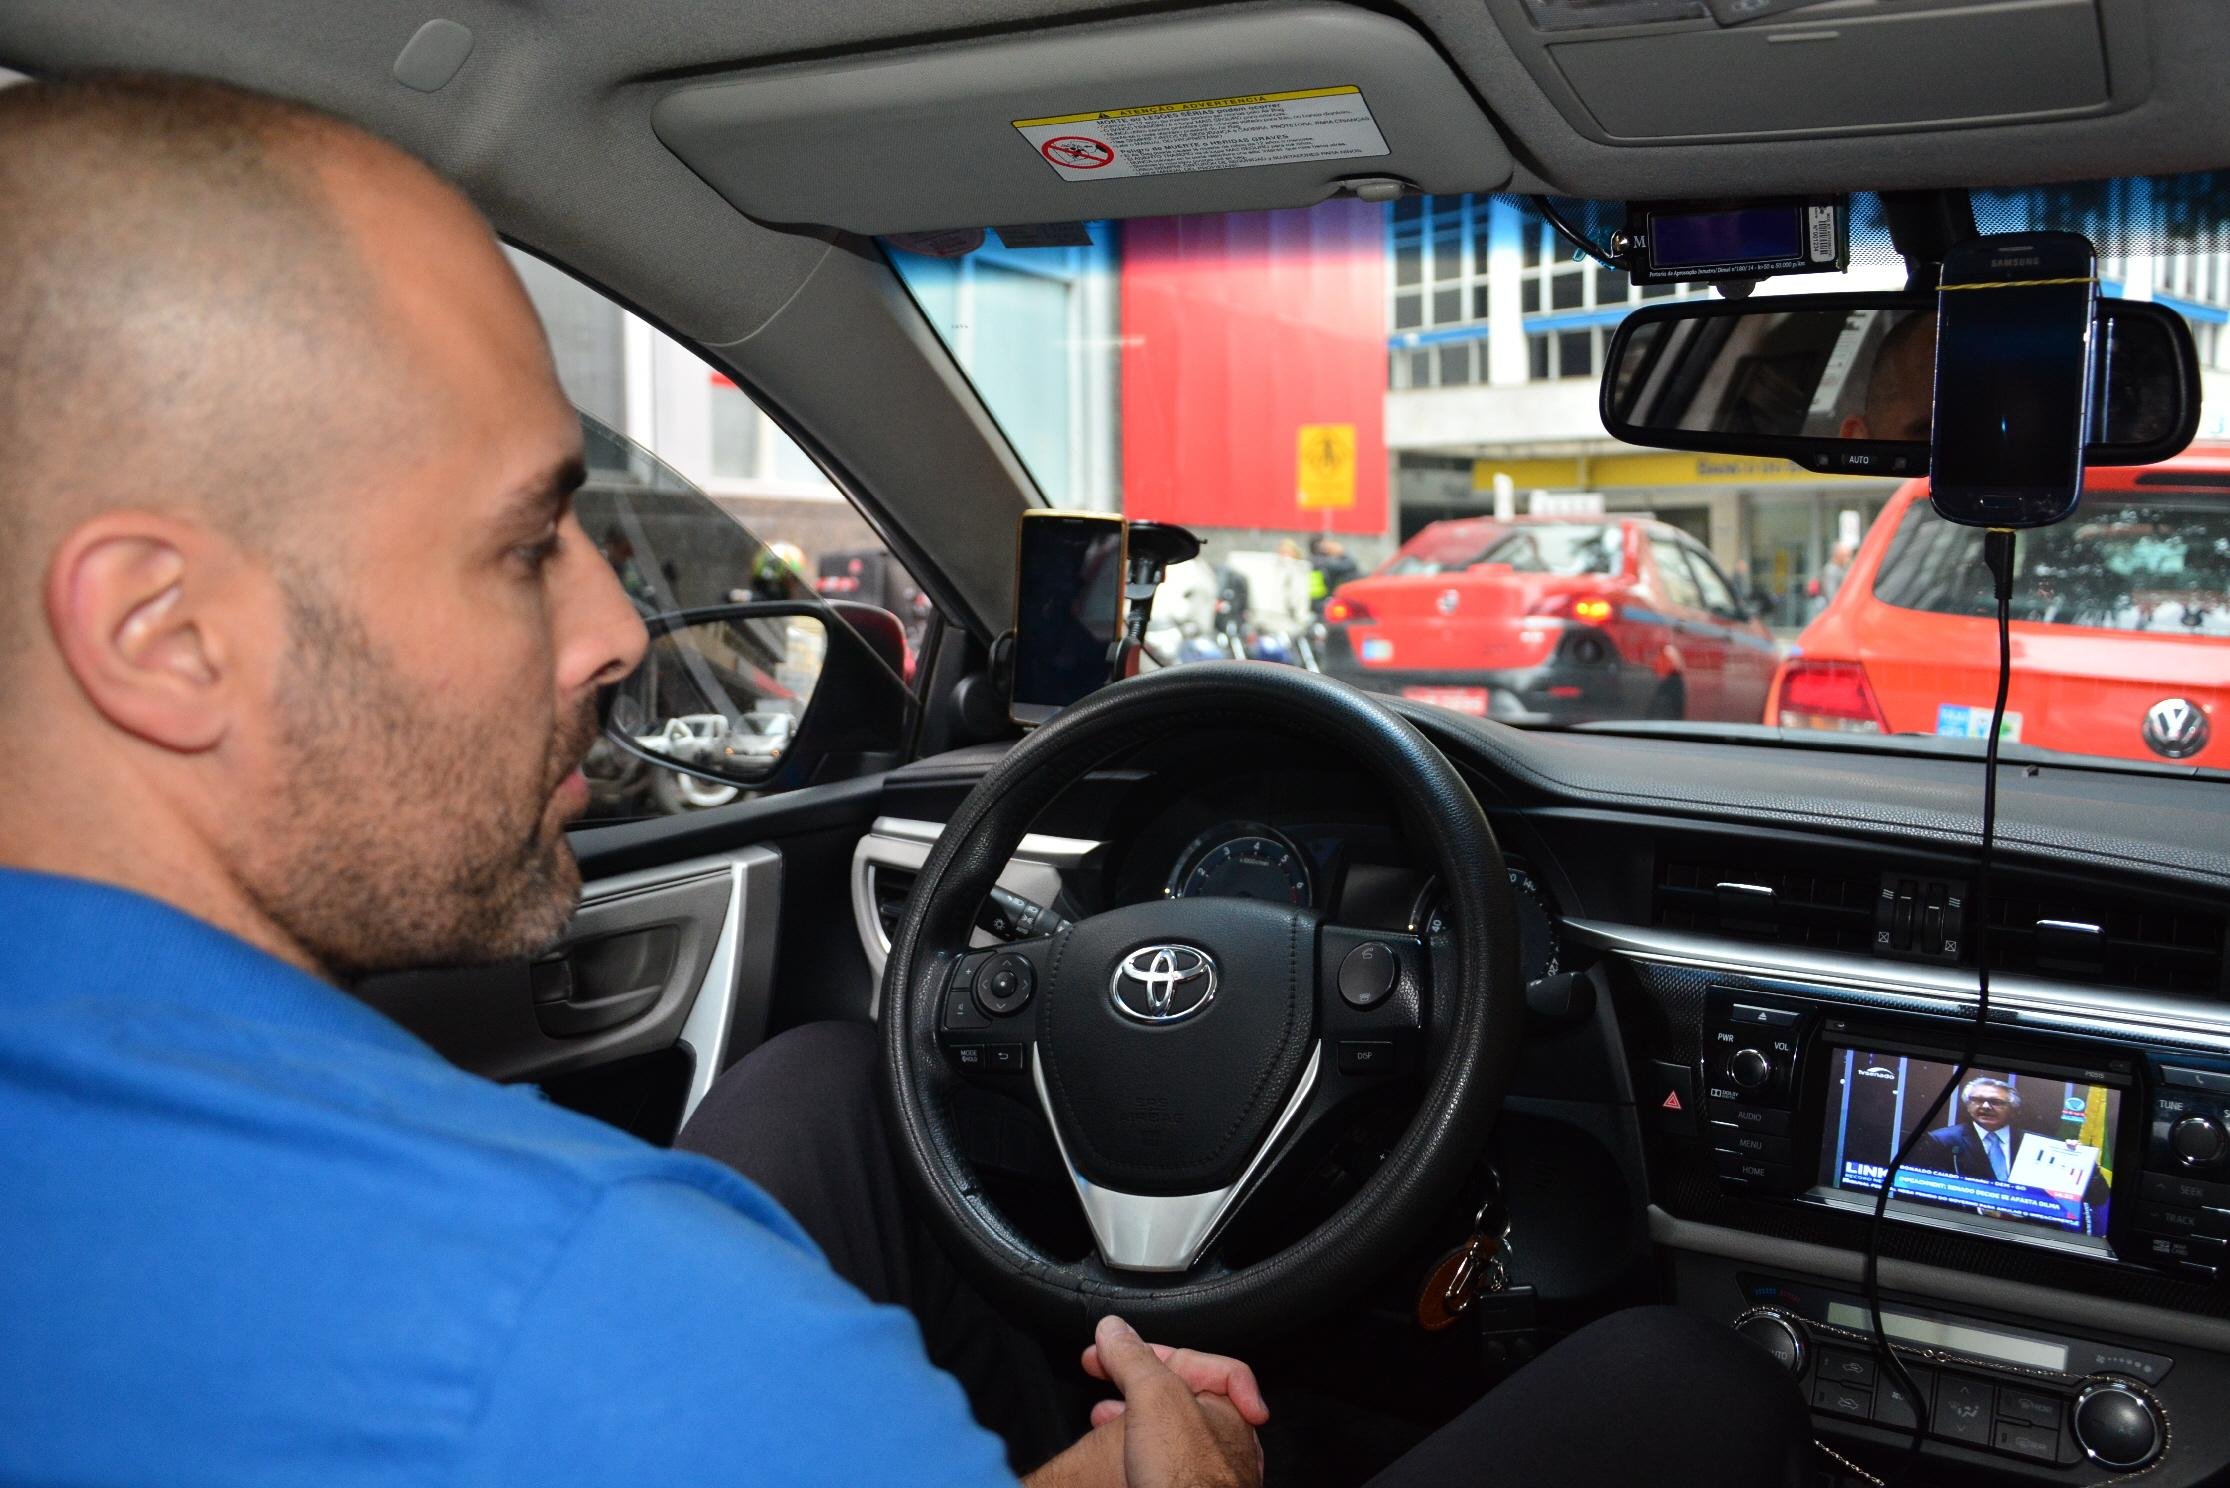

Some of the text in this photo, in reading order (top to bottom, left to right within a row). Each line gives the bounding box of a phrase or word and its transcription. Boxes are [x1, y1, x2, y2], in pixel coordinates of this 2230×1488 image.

[1634, 235, 1647, 249] M
[1991, 257, 2040, 267] SAMSUNG
[1849, 456, 1869, 464] AUTO
[1717, 1032, 1735, 1042] PWR
[1774, 1041, 1789, 1051] VOL
[2160, 1099, 2183, 1111] TUNE
[1738, 1111, 1762, 1122] AUDIO
[1739, 1138, 1762, 1150] MENU
[1742, 1165, 1765, 1177] HOME
[2166, 1213, 2195, 1225] TRACK
